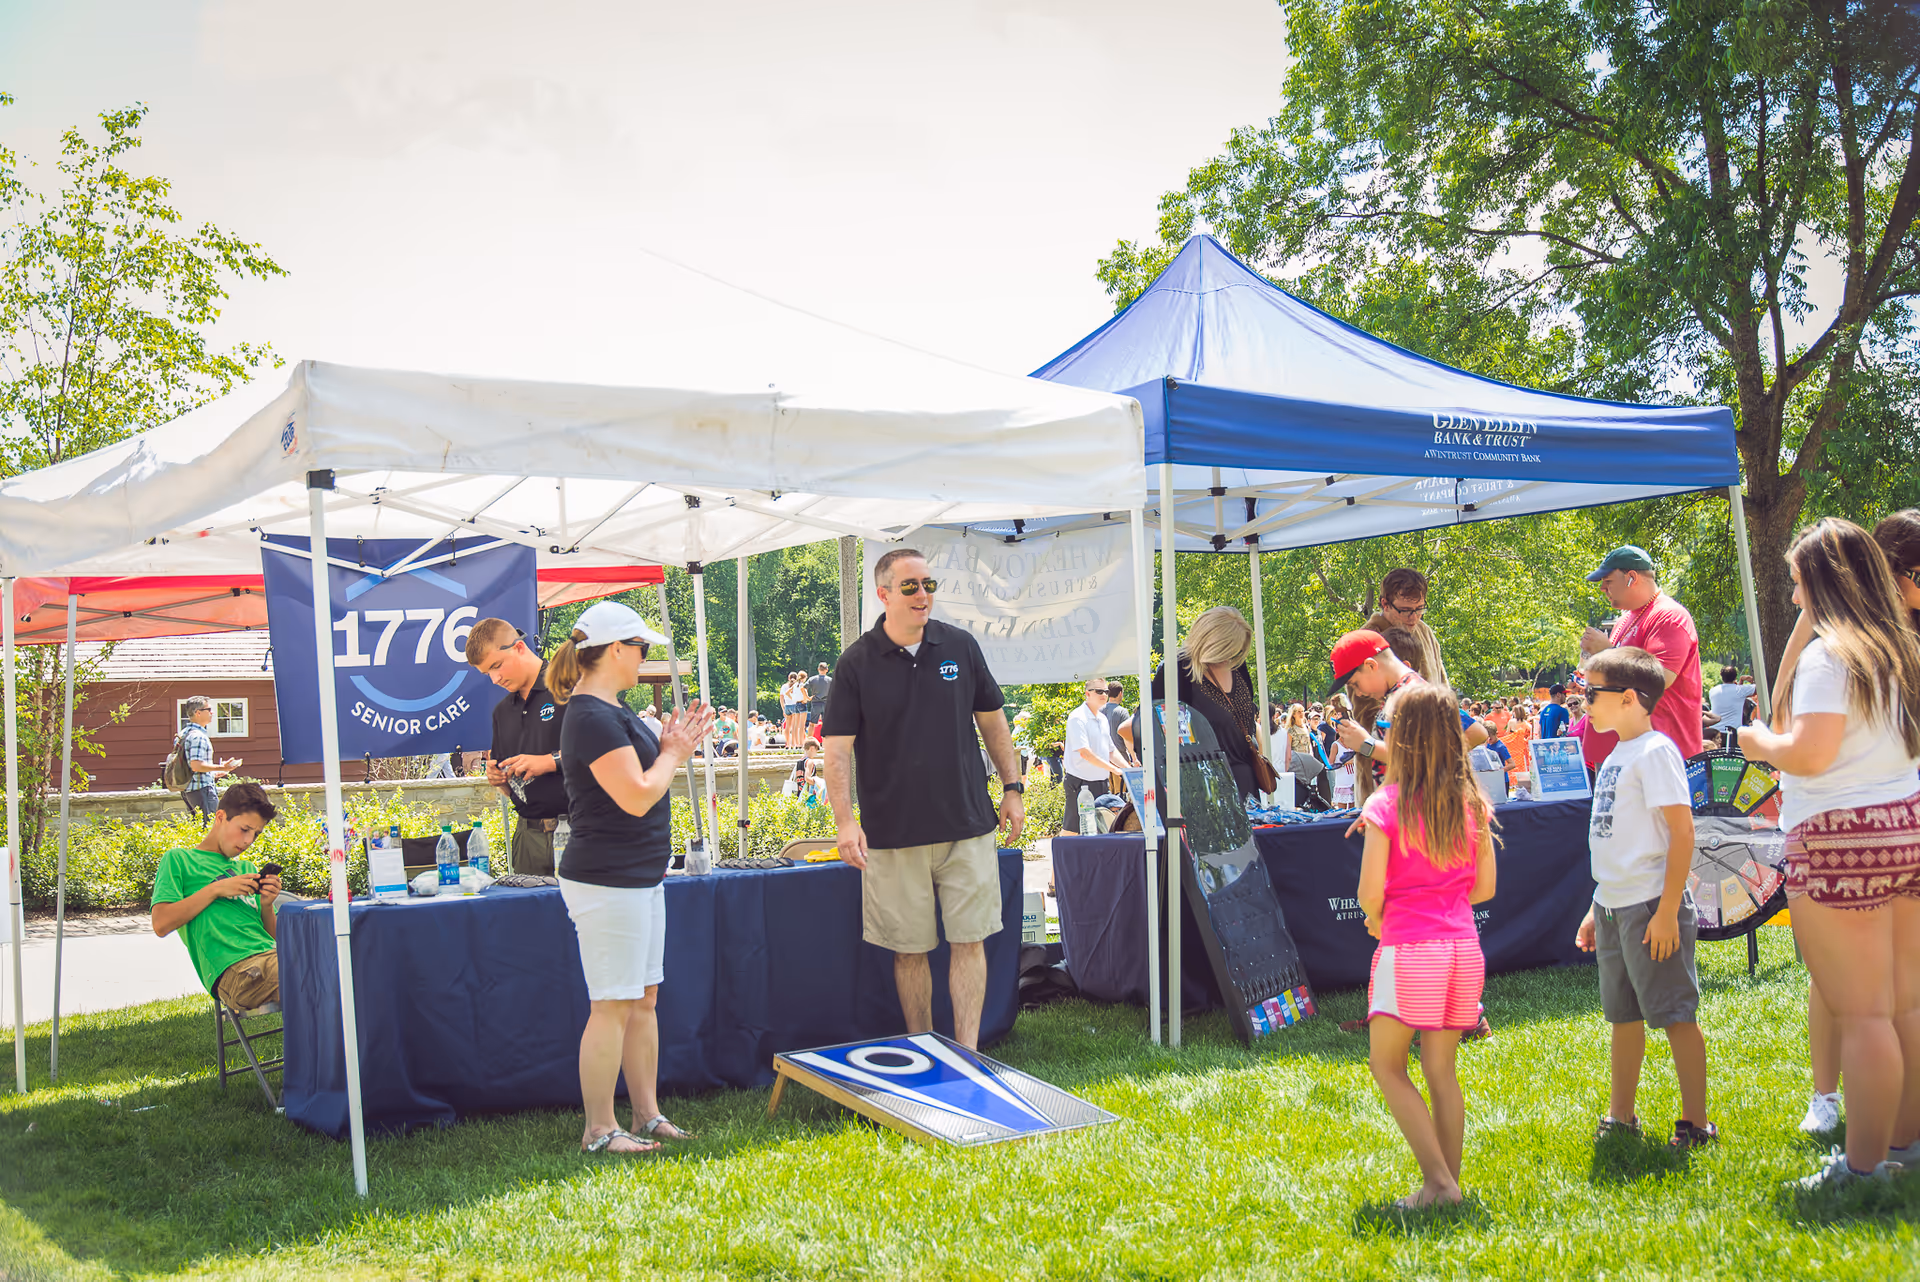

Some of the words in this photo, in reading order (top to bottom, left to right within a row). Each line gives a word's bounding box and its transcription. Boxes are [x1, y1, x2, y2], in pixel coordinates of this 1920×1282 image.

[1434, 431, 1471, 445] BANK
[1472, 433, 1482, 446] &
[1473, 451, 1519, 463] COMMUNITY
[1521, 453, 1541, 463] BANK
[333, 606, 479, 667] 1776
[939, 664, 959, 674] 1776
[351, 701, 421, 735] SENIOR
[425, 696, 471, 732] CARE
[1755, 871, 1777, 899] CANDY
[1328, 897, 1361, 911] WHEA
[1726, 900, 1752, 917] CANDY
